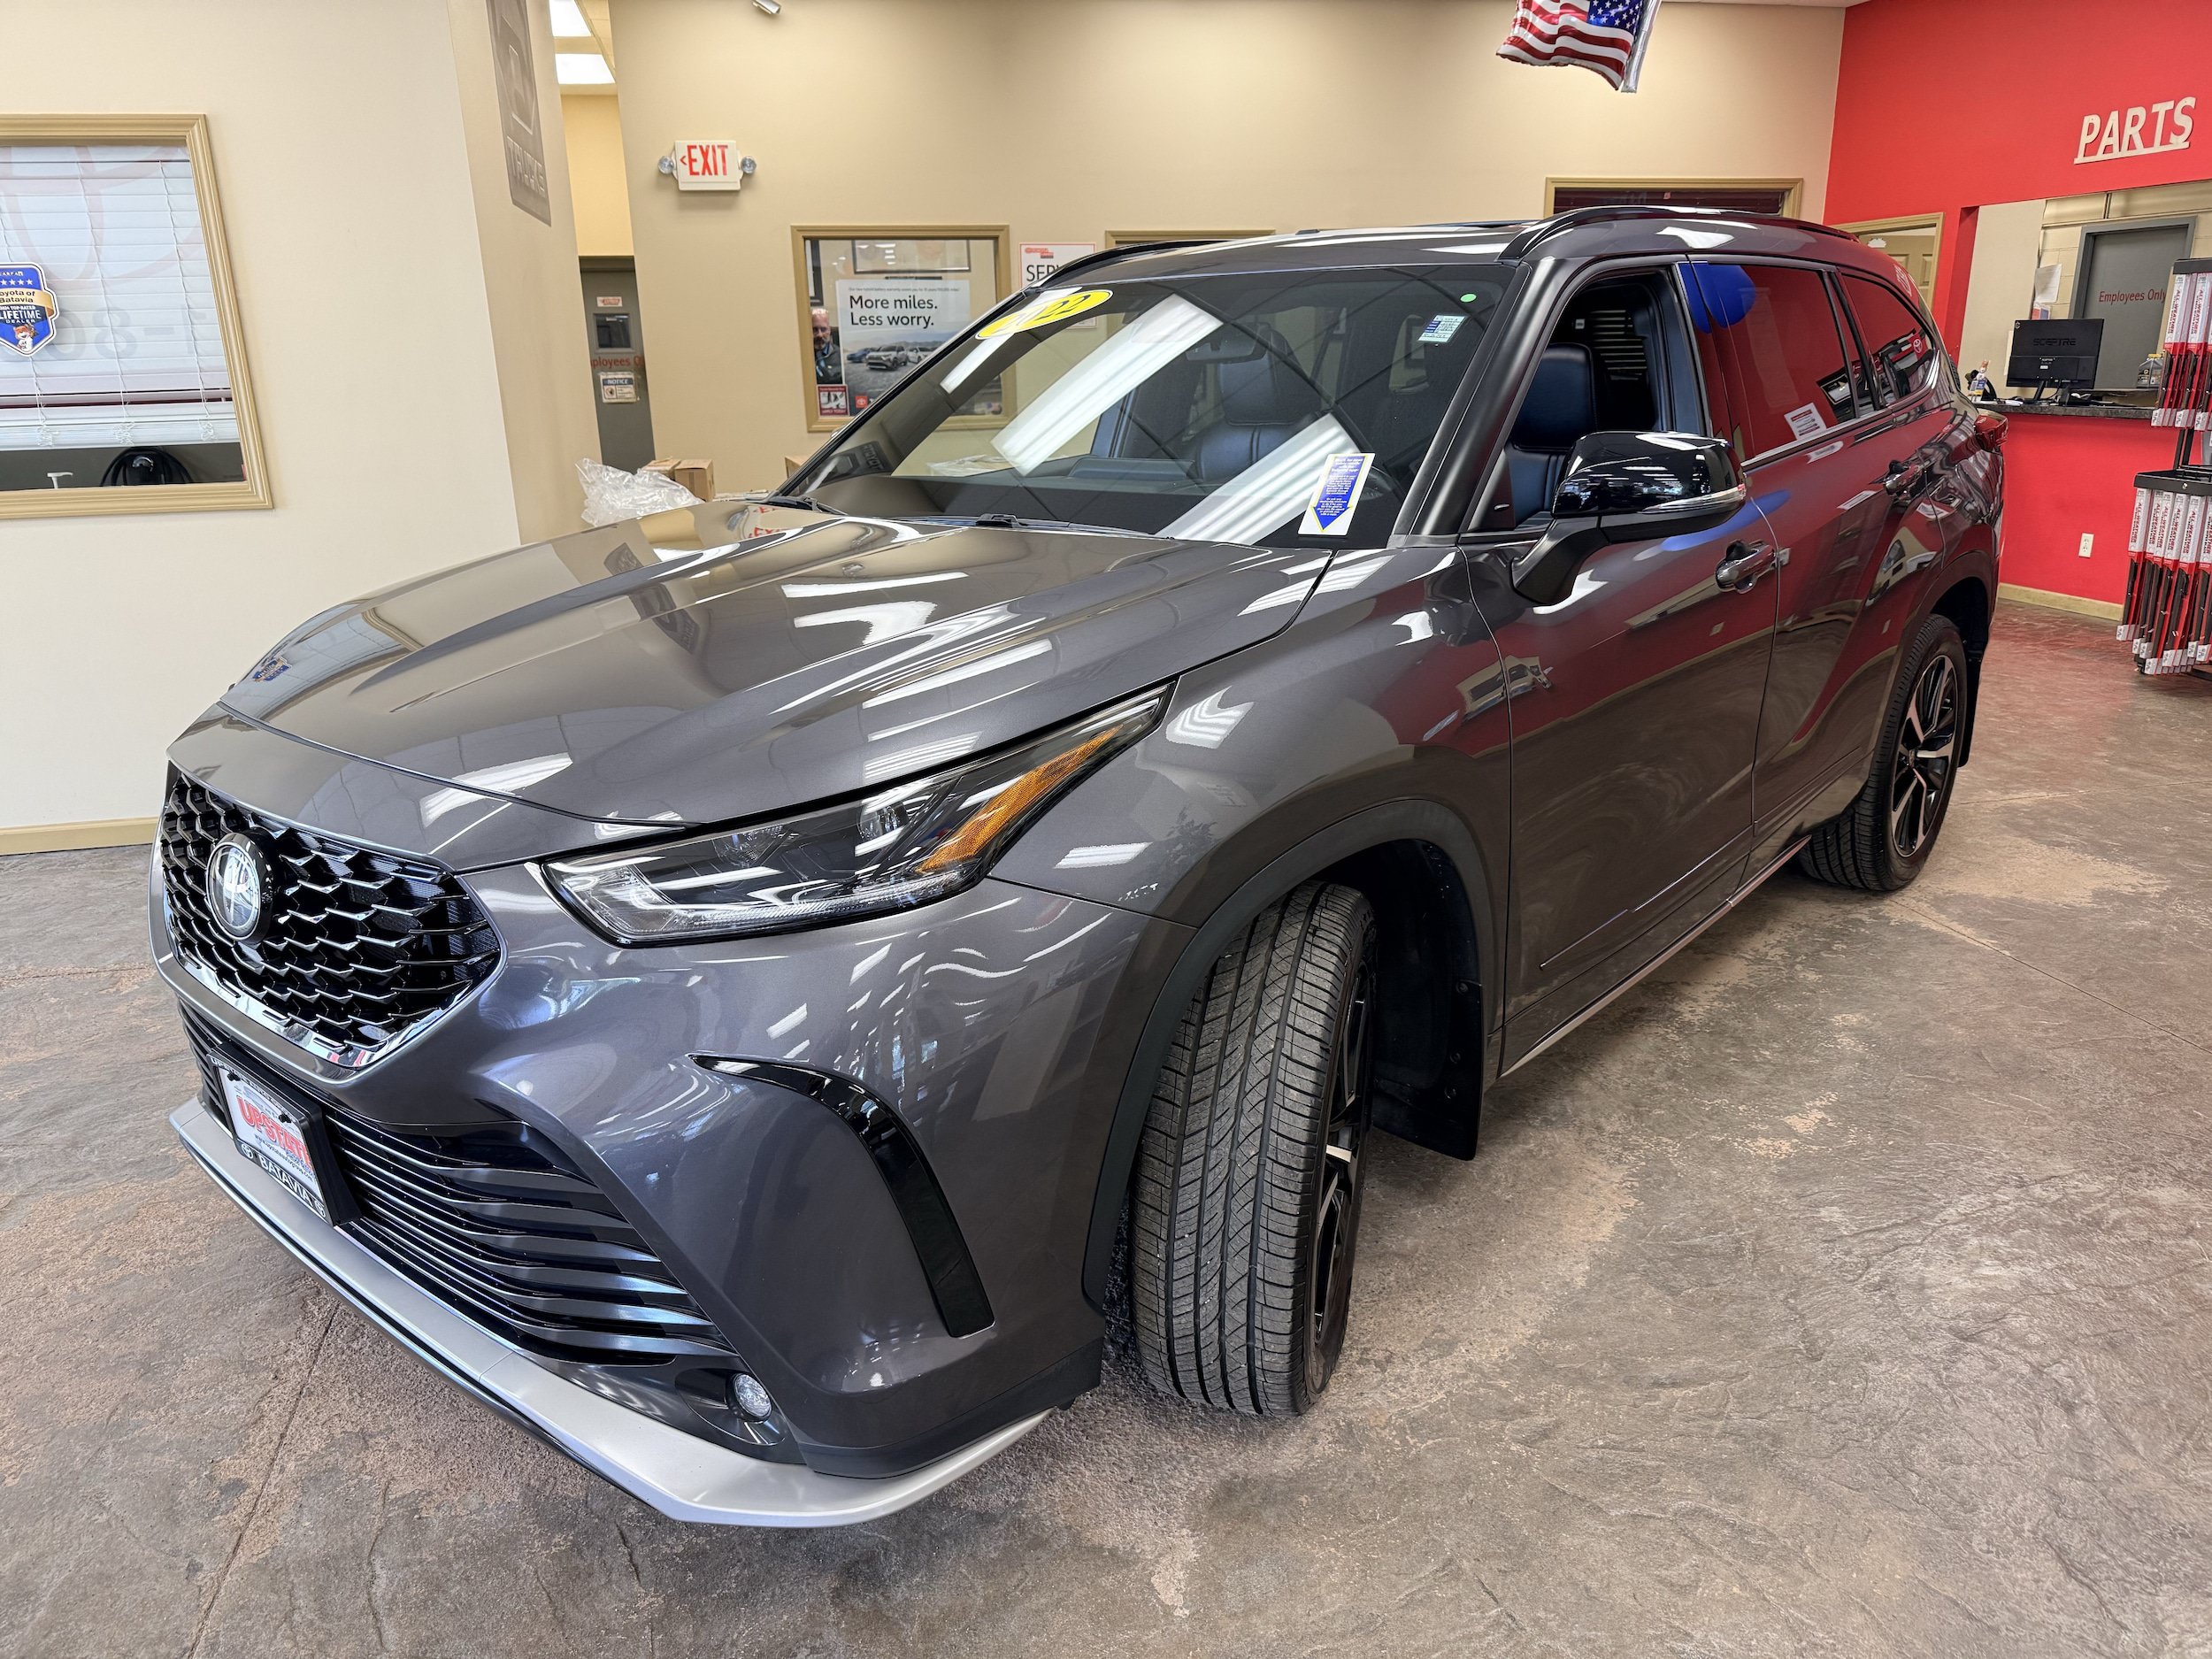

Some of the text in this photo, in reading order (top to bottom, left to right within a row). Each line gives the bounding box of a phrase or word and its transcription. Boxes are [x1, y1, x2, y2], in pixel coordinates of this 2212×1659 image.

[2076, 96, 2197, 161] PARTS
[687, 145, 728, 176] EXIT
[1026, 265, 1059, 281] SER
[849, 295, 938, 310] More miles.
[2099, 288, 2167, 305] Employees Only
[850, 311, 934, 330] Less worry.
[2032, 338, 2078, 347] SCEPTRE
[590, 357, 631, 368] ployees
[259, 1155, 313, 1207] BATAVIA
